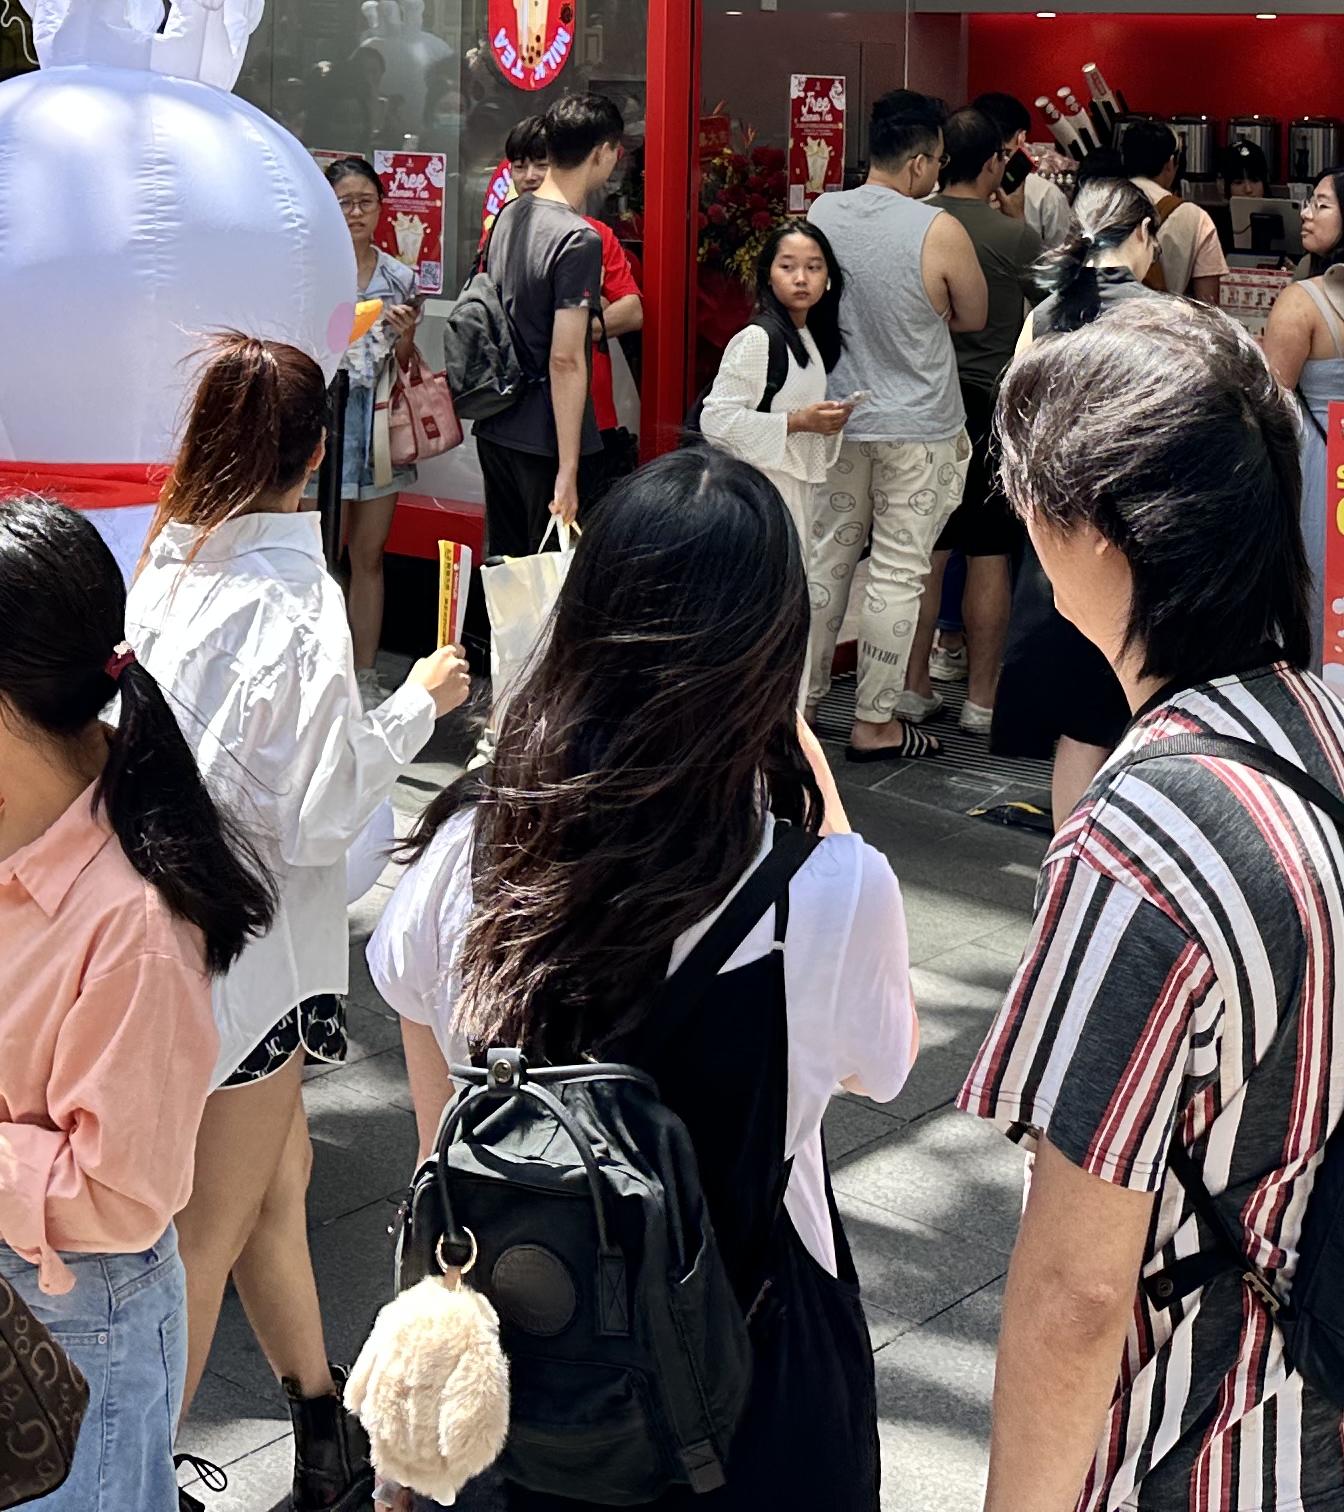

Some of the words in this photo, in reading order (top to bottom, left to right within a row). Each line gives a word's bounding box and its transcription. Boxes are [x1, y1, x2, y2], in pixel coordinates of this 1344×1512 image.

[493, 27, 525, 80] TEA
[534, 27, 571, 81] MILK
[802, 91, 832, 114] Free
[390, 167, 428, 191] Free
